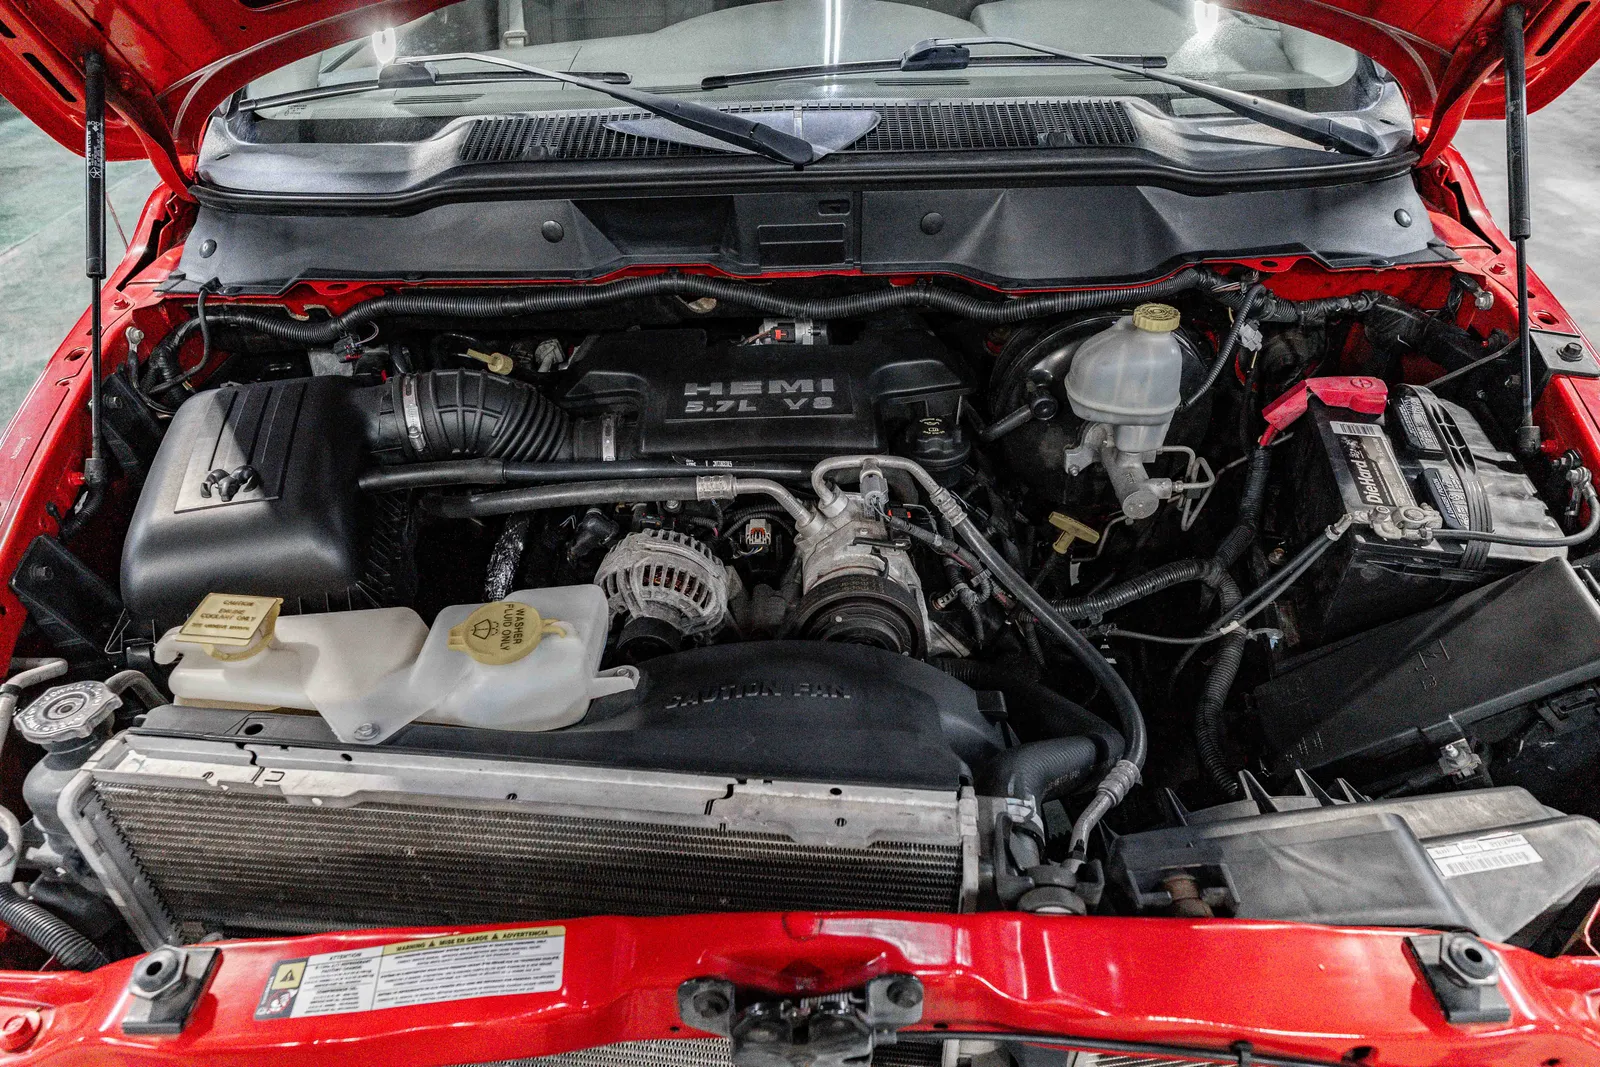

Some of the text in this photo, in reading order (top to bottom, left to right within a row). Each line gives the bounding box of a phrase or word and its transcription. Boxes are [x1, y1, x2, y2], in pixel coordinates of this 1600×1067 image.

[684, 378, 835, 396] HEMI
[684, 396, 834, 413] 5.7L V8
[1350, 459, 1384, 504] DieHard
[200, 612, 235, 620] COOLANT
[500, 604, 515, 651] FLUID ONLY
[513, 608, 525, 645] WASHER
[665, 681, 851, 709] CAUTION FAN
[396, 942, 426, 952] WARNING
[502, 930, 548, 939] ADVERTENCIA
